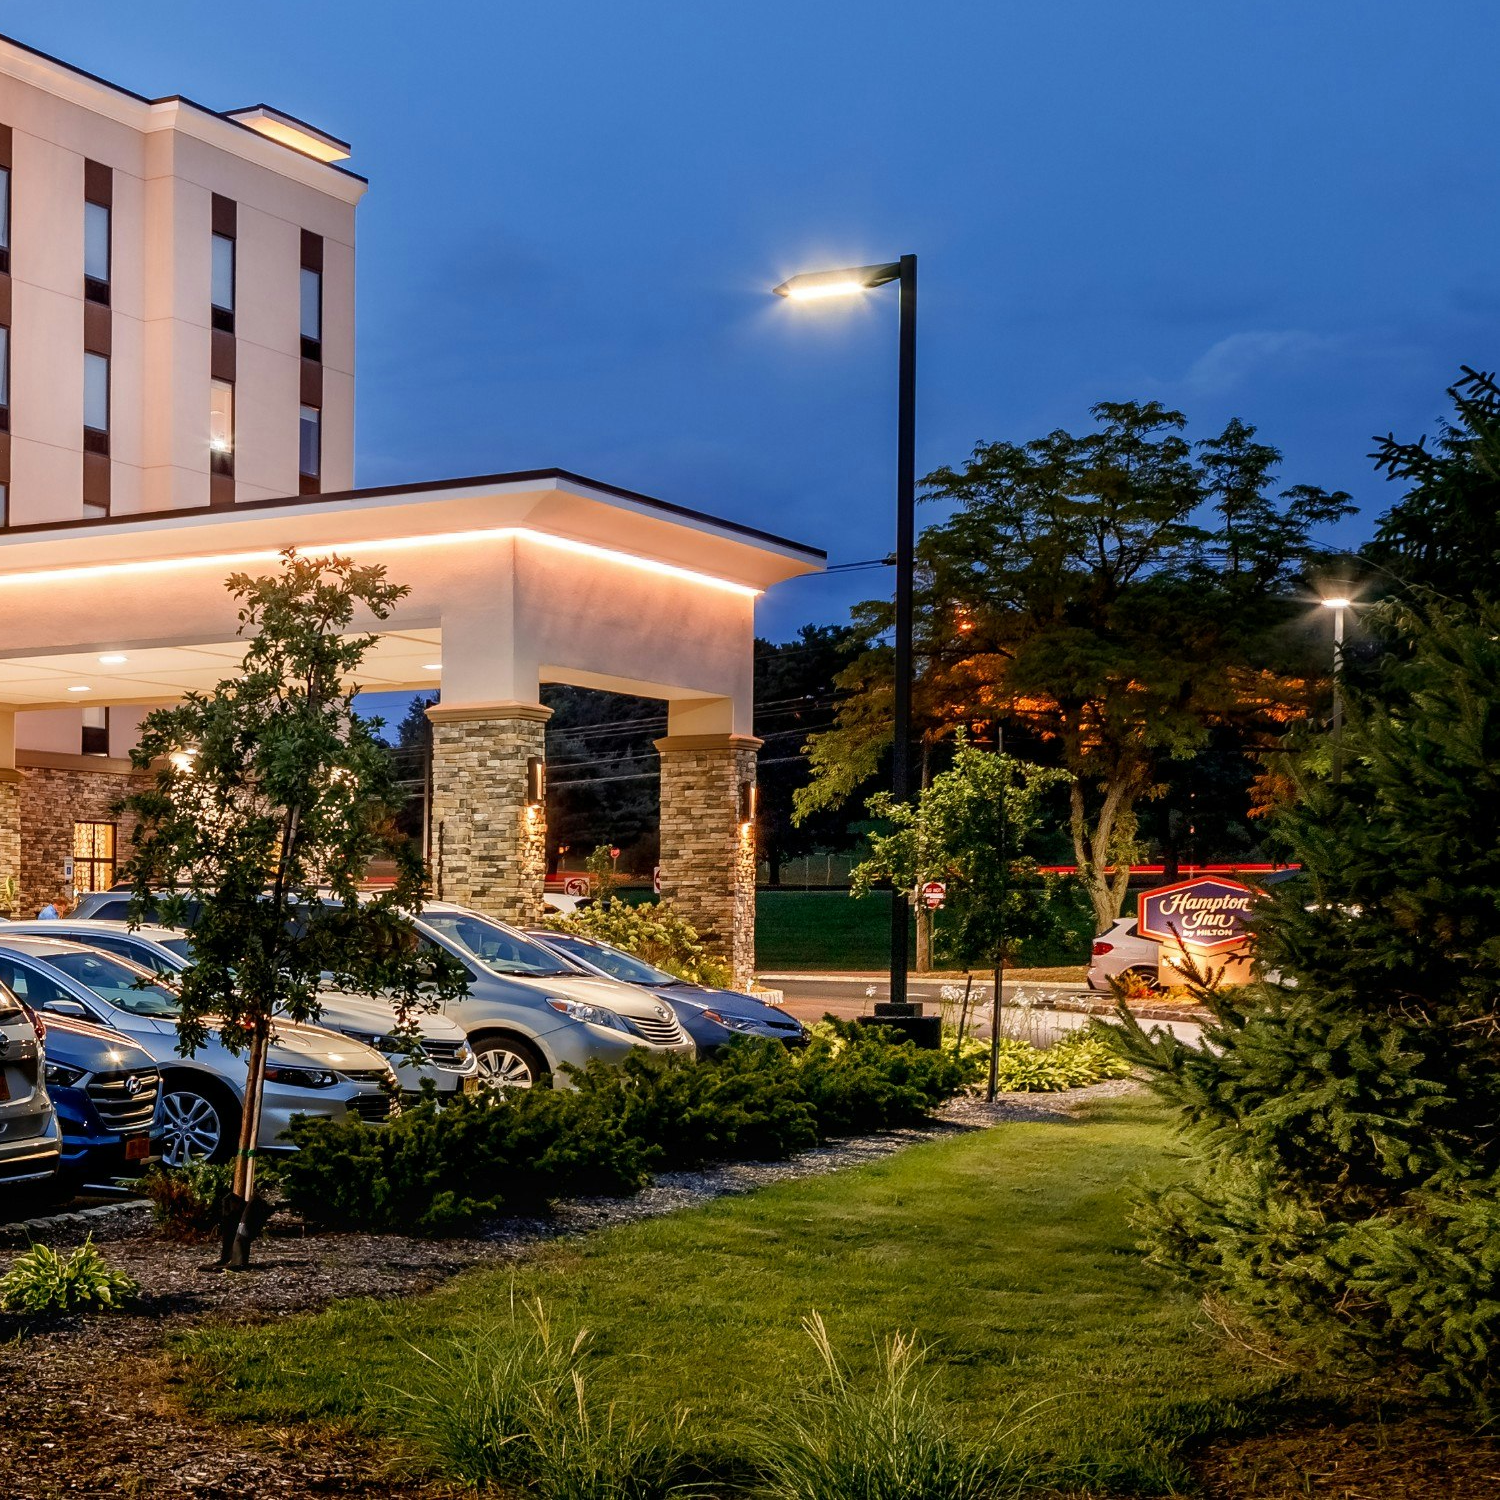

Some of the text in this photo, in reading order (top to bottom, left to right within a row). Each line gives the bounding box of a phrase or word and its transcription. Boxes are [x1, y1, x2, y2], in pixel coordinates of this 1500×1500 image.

[1160, 893, 1252, 915] Hampton
[1181, 909, 1235, 929] Inn
[1183, 929, 1195, 938] by
